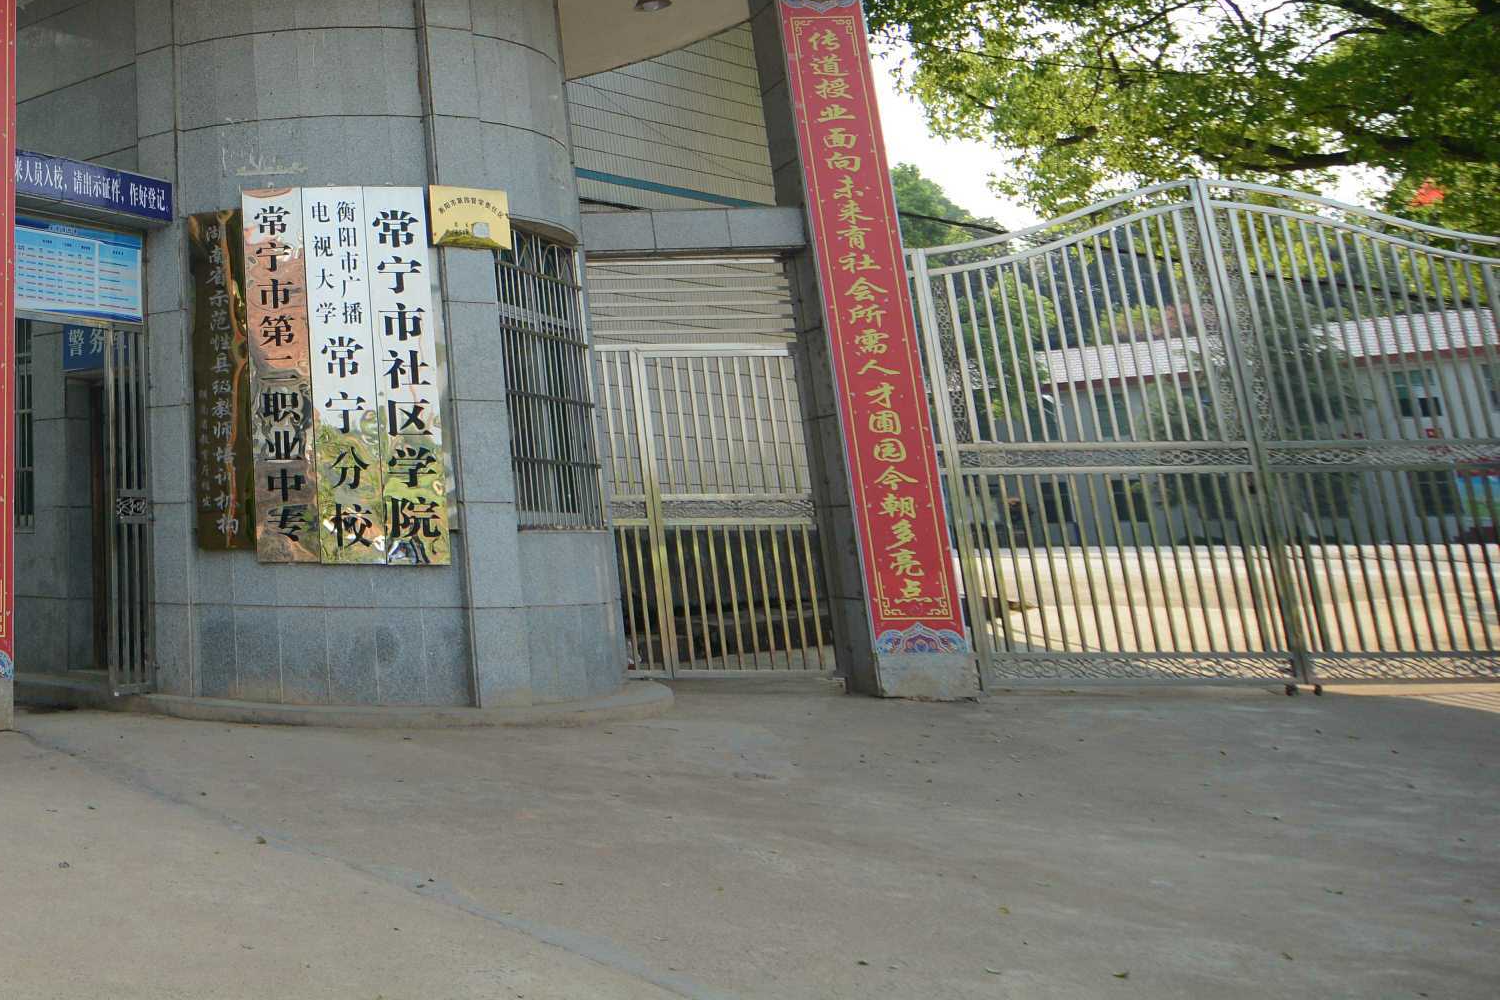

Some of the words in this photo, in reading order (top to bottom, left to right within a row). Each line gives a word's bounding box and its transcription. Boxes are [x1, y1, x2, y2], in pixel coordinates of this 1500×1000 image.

[310, 200, 338, 325] 电视大学
[335, 200, 363, 326] 衡阳市广播
[253, 205, 310, 542] 常宁市第二职业中专
[320, 335, 374, 548] 常宁分校
[371, 208, 441, 541] 常宁市社区学院
